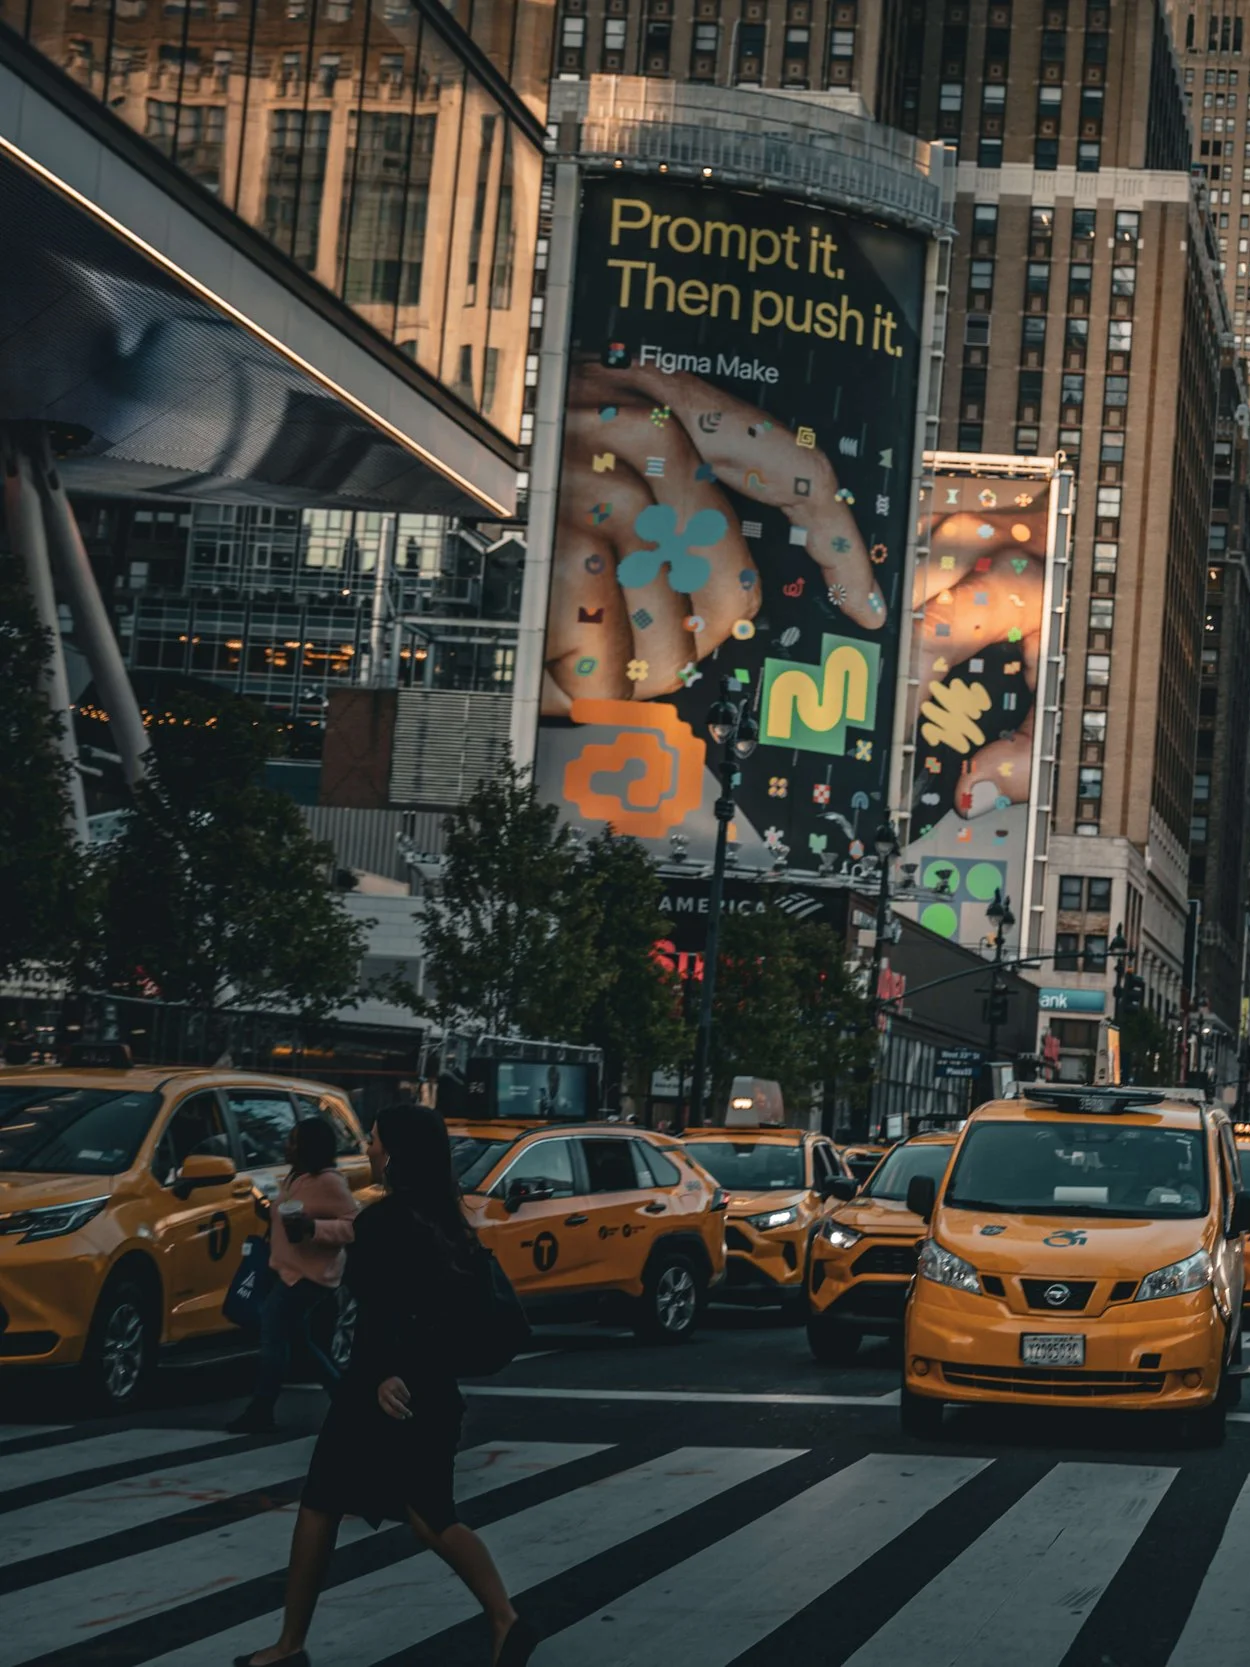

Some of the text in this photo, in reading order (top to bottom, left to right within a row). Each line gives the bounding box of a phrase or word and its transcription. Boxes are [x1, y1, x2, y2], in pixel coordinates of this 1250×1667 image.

[610, 197, 846, 281] Prompt it.
[607, 259, 903, 359] Then push it.
[639, 345, 780, 385] Figma Make
